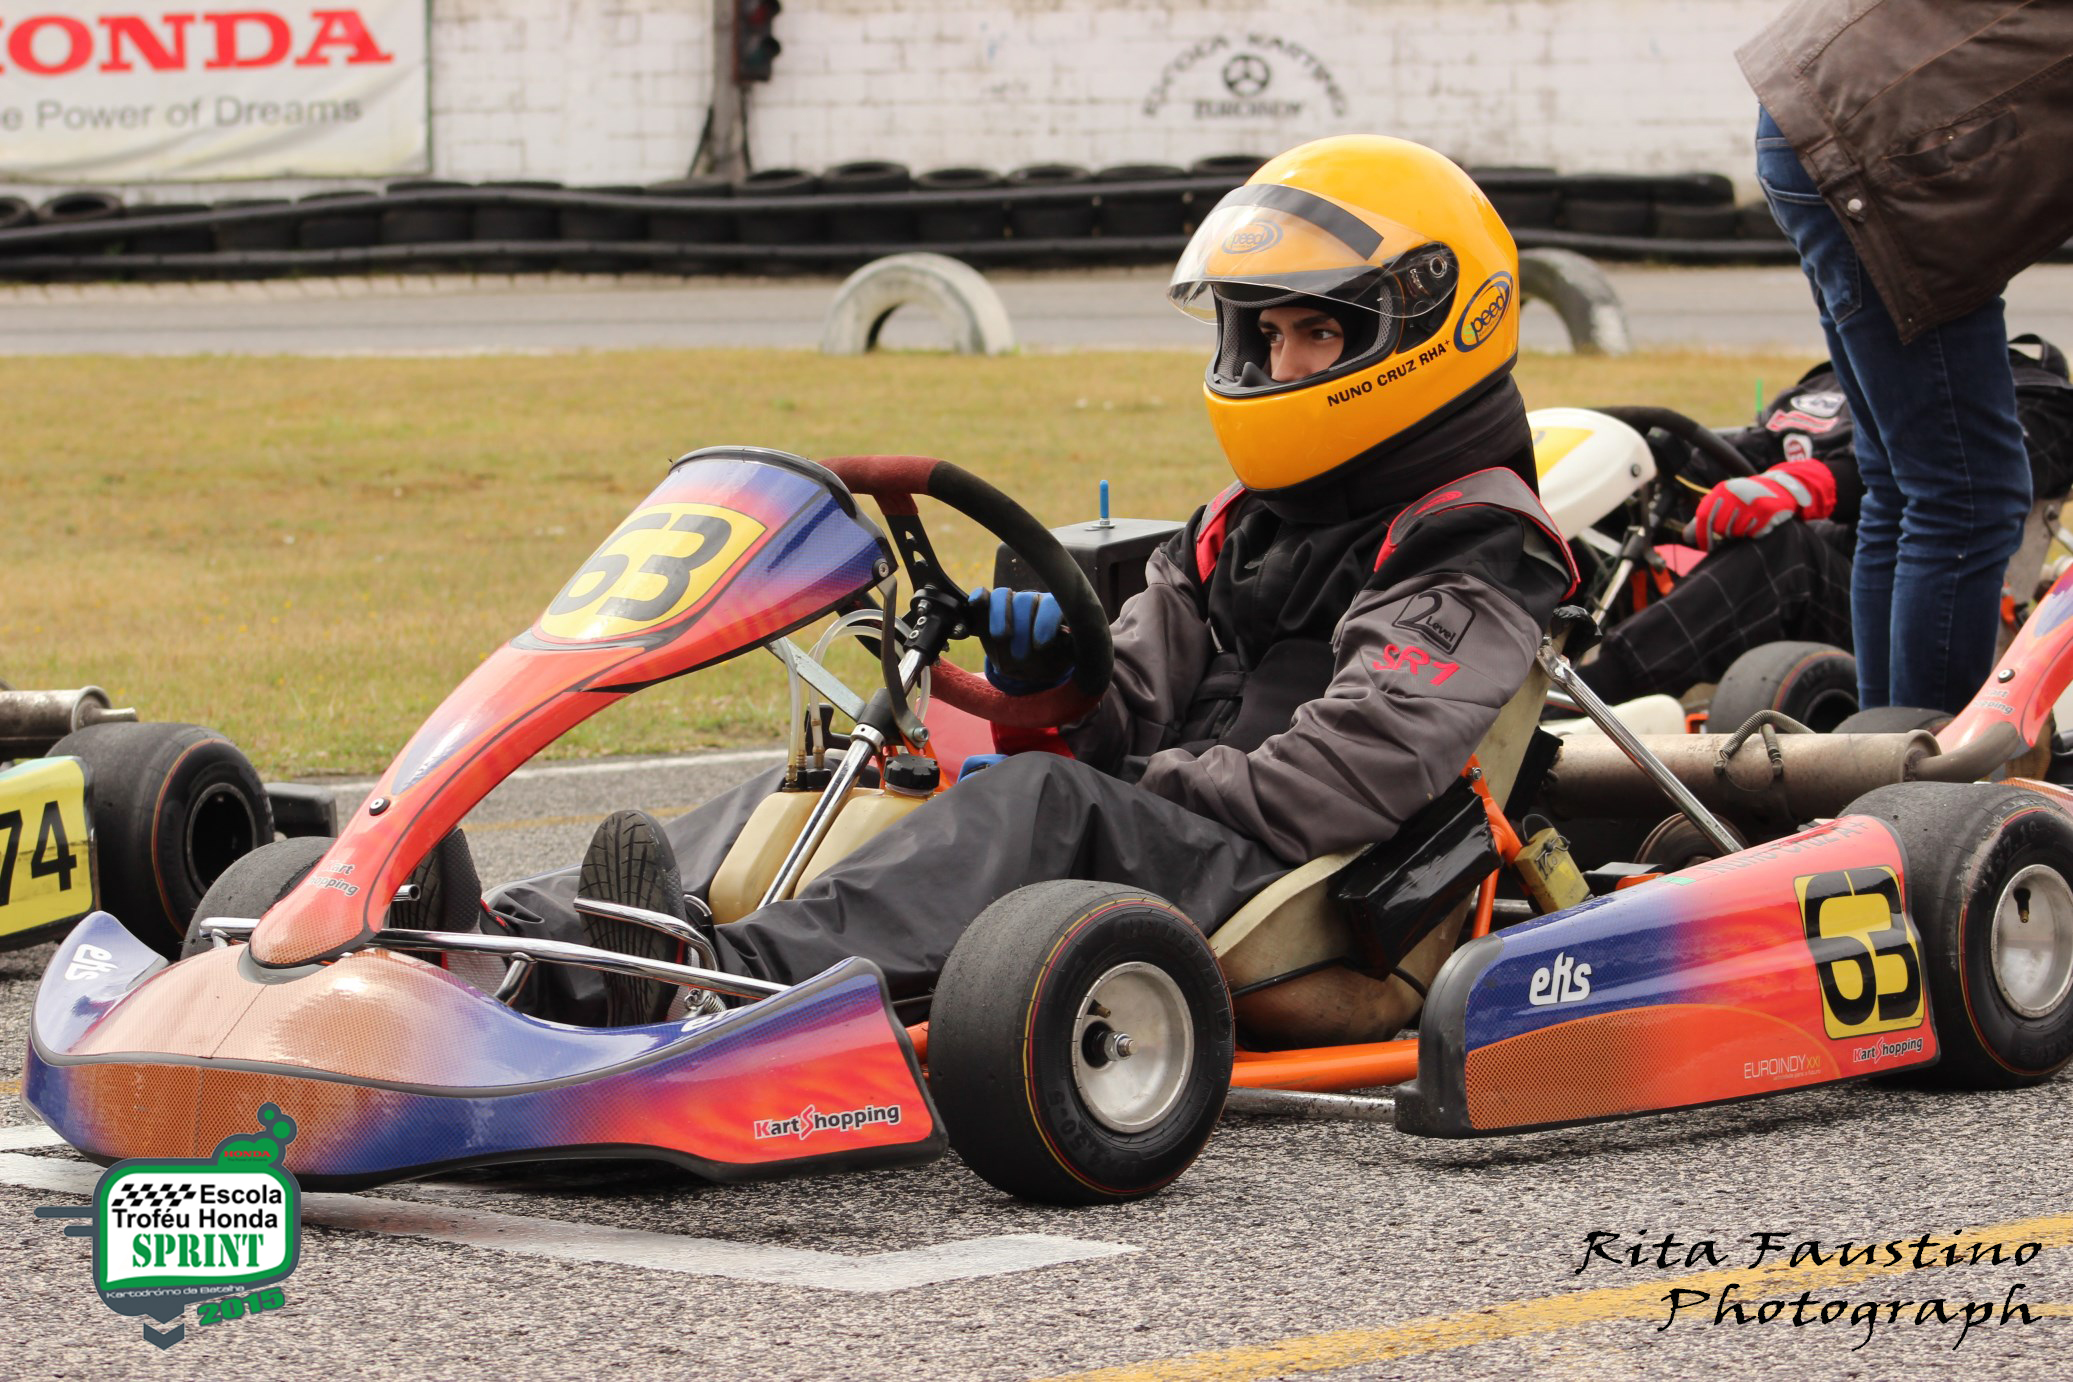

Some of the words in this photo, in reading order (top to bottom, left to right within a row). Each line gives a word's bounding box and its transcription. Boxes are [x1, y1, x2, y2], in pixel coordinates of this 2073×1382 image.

[0, 9, 394, 76] ONDA
[36, 97, 154, 131] Power
[165, 97, 200, 128] of
[214, 96, 363, 129] Dreams
[1327, 381, 1373, 407] NUNO
[1376, 359, 1417, 387] CRUZ
[549, 512, 732, 622] 63
[1397, 591, 1452, 651] 2
[1425, 616, 1457, 642] Level
[0, 801, 77, 906] 74
[1805, 868, 1921, 1026] 63
[1743, 1054, 1806, 1079] EUROINDY
[1853, 1037, 1924, 1065] KartShopping
[753, 1104, 902, 1141] KartShopping
